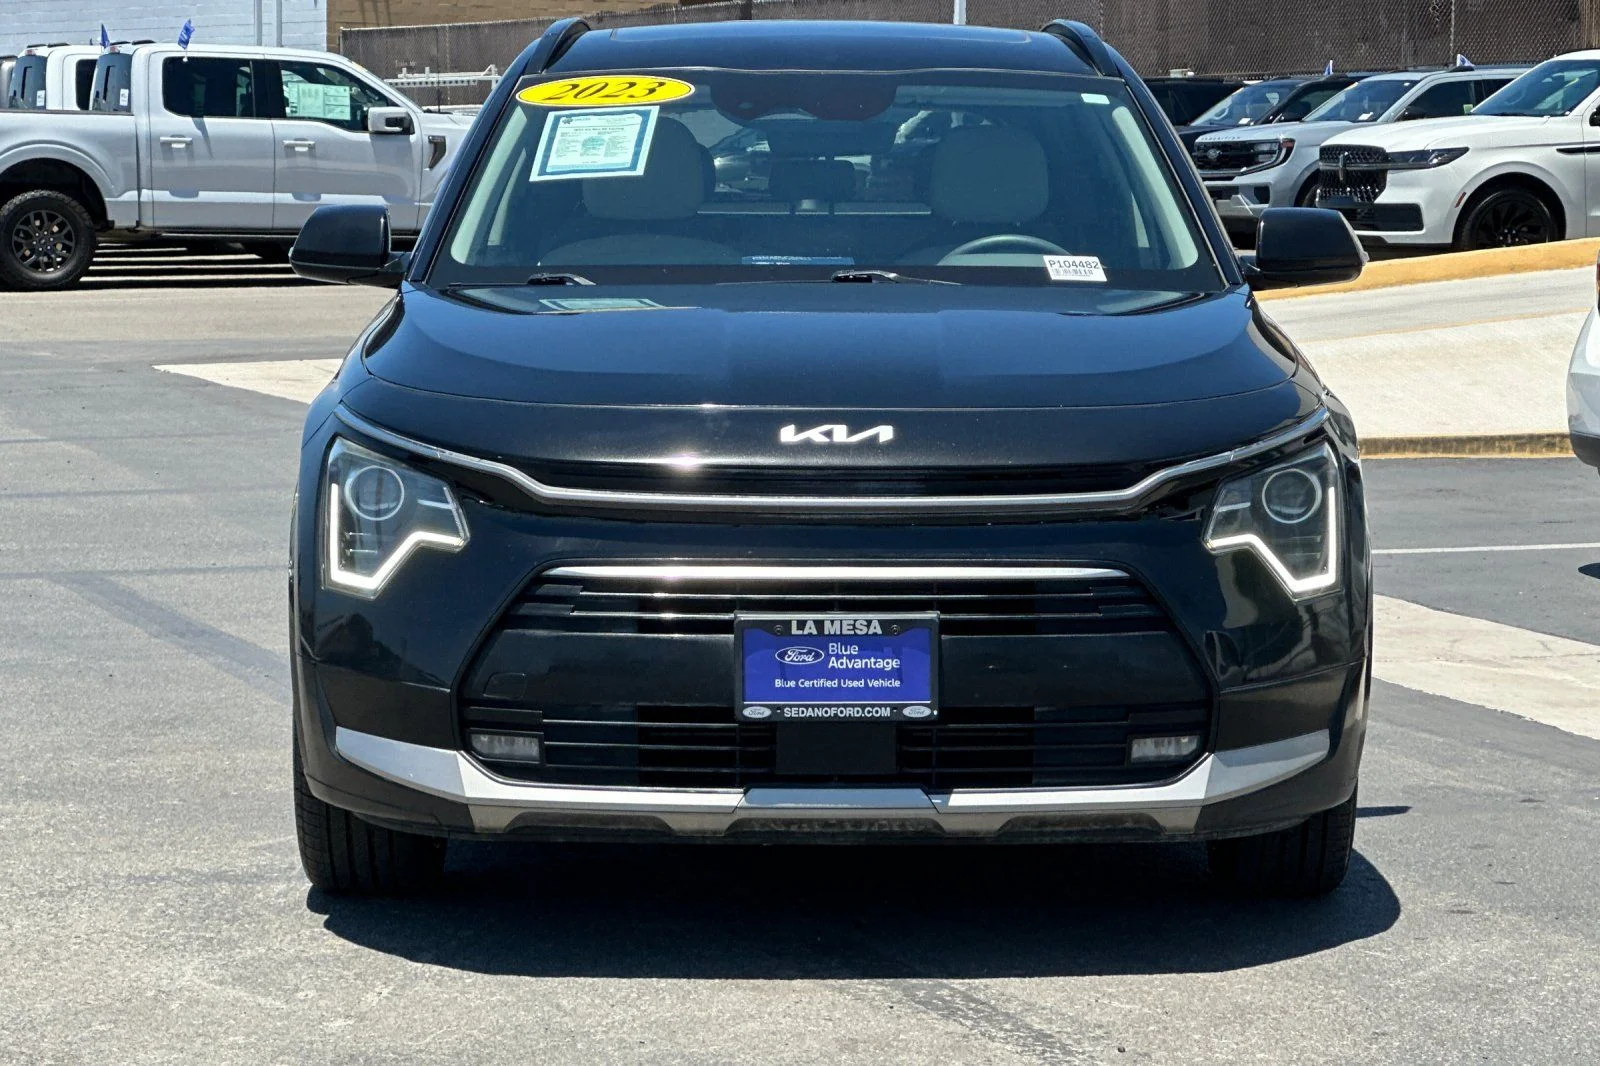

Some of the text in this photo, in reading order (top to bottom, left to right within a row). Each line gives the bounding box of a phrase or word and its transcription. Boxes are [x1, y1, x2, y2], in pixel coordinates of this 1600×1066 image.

[542, 81, 667, 101] 2023
[1048, 260, 1099, 270] P104482
[780, 424, 894, 443] KIA
[791, 620, 882, 635] LA MESA
[784, 649, 814, 662] Ford
[829, 643, 859, 655] Blue
[828, 656, 901, 671] Advantage
[775, 678, 901, 688] Blue Certified Used Vehicle
[784, 707, 891, 717] SEDANOFORD.COM
